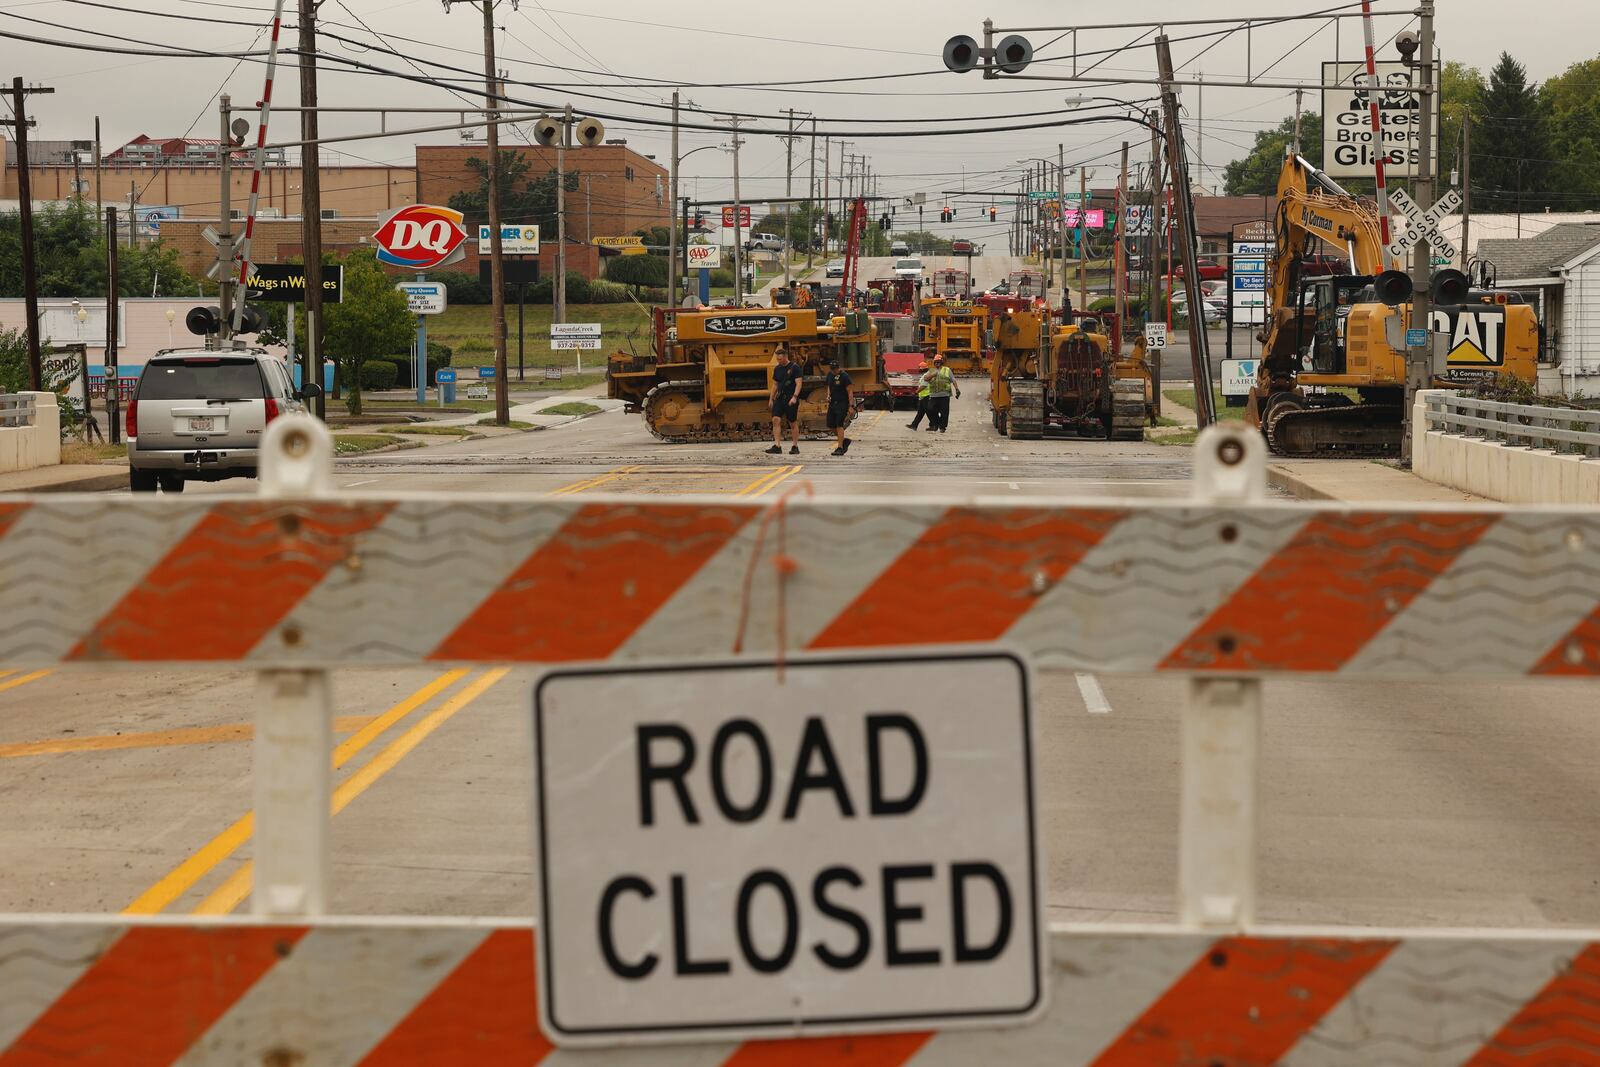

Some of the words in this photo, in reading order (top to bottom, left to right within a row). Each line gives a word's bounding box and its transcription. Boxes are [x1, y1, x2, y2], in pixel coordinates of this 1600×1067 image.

[1336, 112, 1420, 126] Gates
[1336, 128, 1420, 142] Broher
[1310, 210, 1333, 231] Corman
[1390, 193, 1459, 256] CROSSING
[389, 219, 449, 255] DQ
[690, 248, 708, 258] AAA
[246, 275, 278, 290] Wags
[280, 280, 288, 289] n
[288, 275, 337, 290] Wies
[1147, 336, 1165, 347] 35
[636, 713, 930, 827] ROAD
[597, 860, 1014, 981] CLOSED
